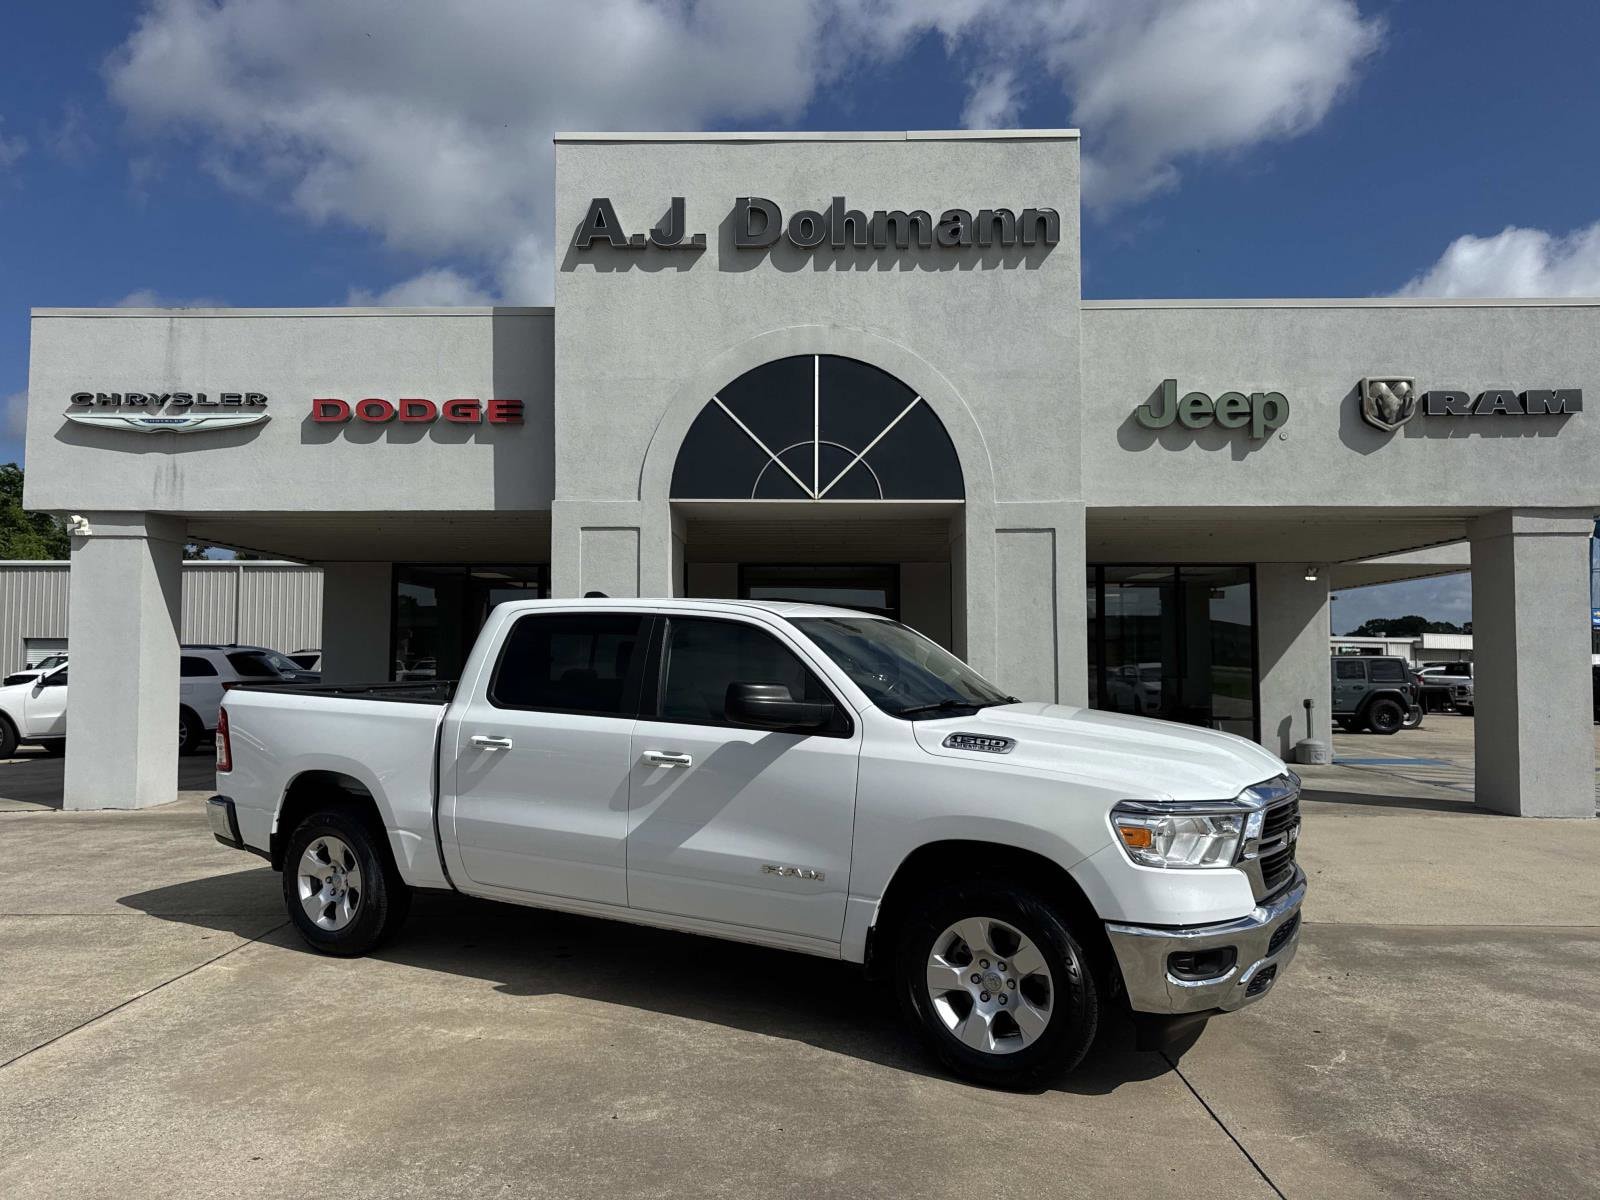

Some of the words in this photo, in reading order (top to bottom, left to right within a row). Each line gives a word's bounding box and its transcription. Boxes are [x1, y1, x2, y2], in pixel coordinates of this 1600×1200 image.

[574, 197, 706, 248] A.J.
[735, 196, 1060, 249] Dohmann
[70, 392, 268, 406] CHRYSLER
[313, 398, 524, 424] DODGE
[1136, 379, 1290, 439] Jeep
[1423, 389, 1583, 416] RAM
[761, 864, 825, 881] RAM
